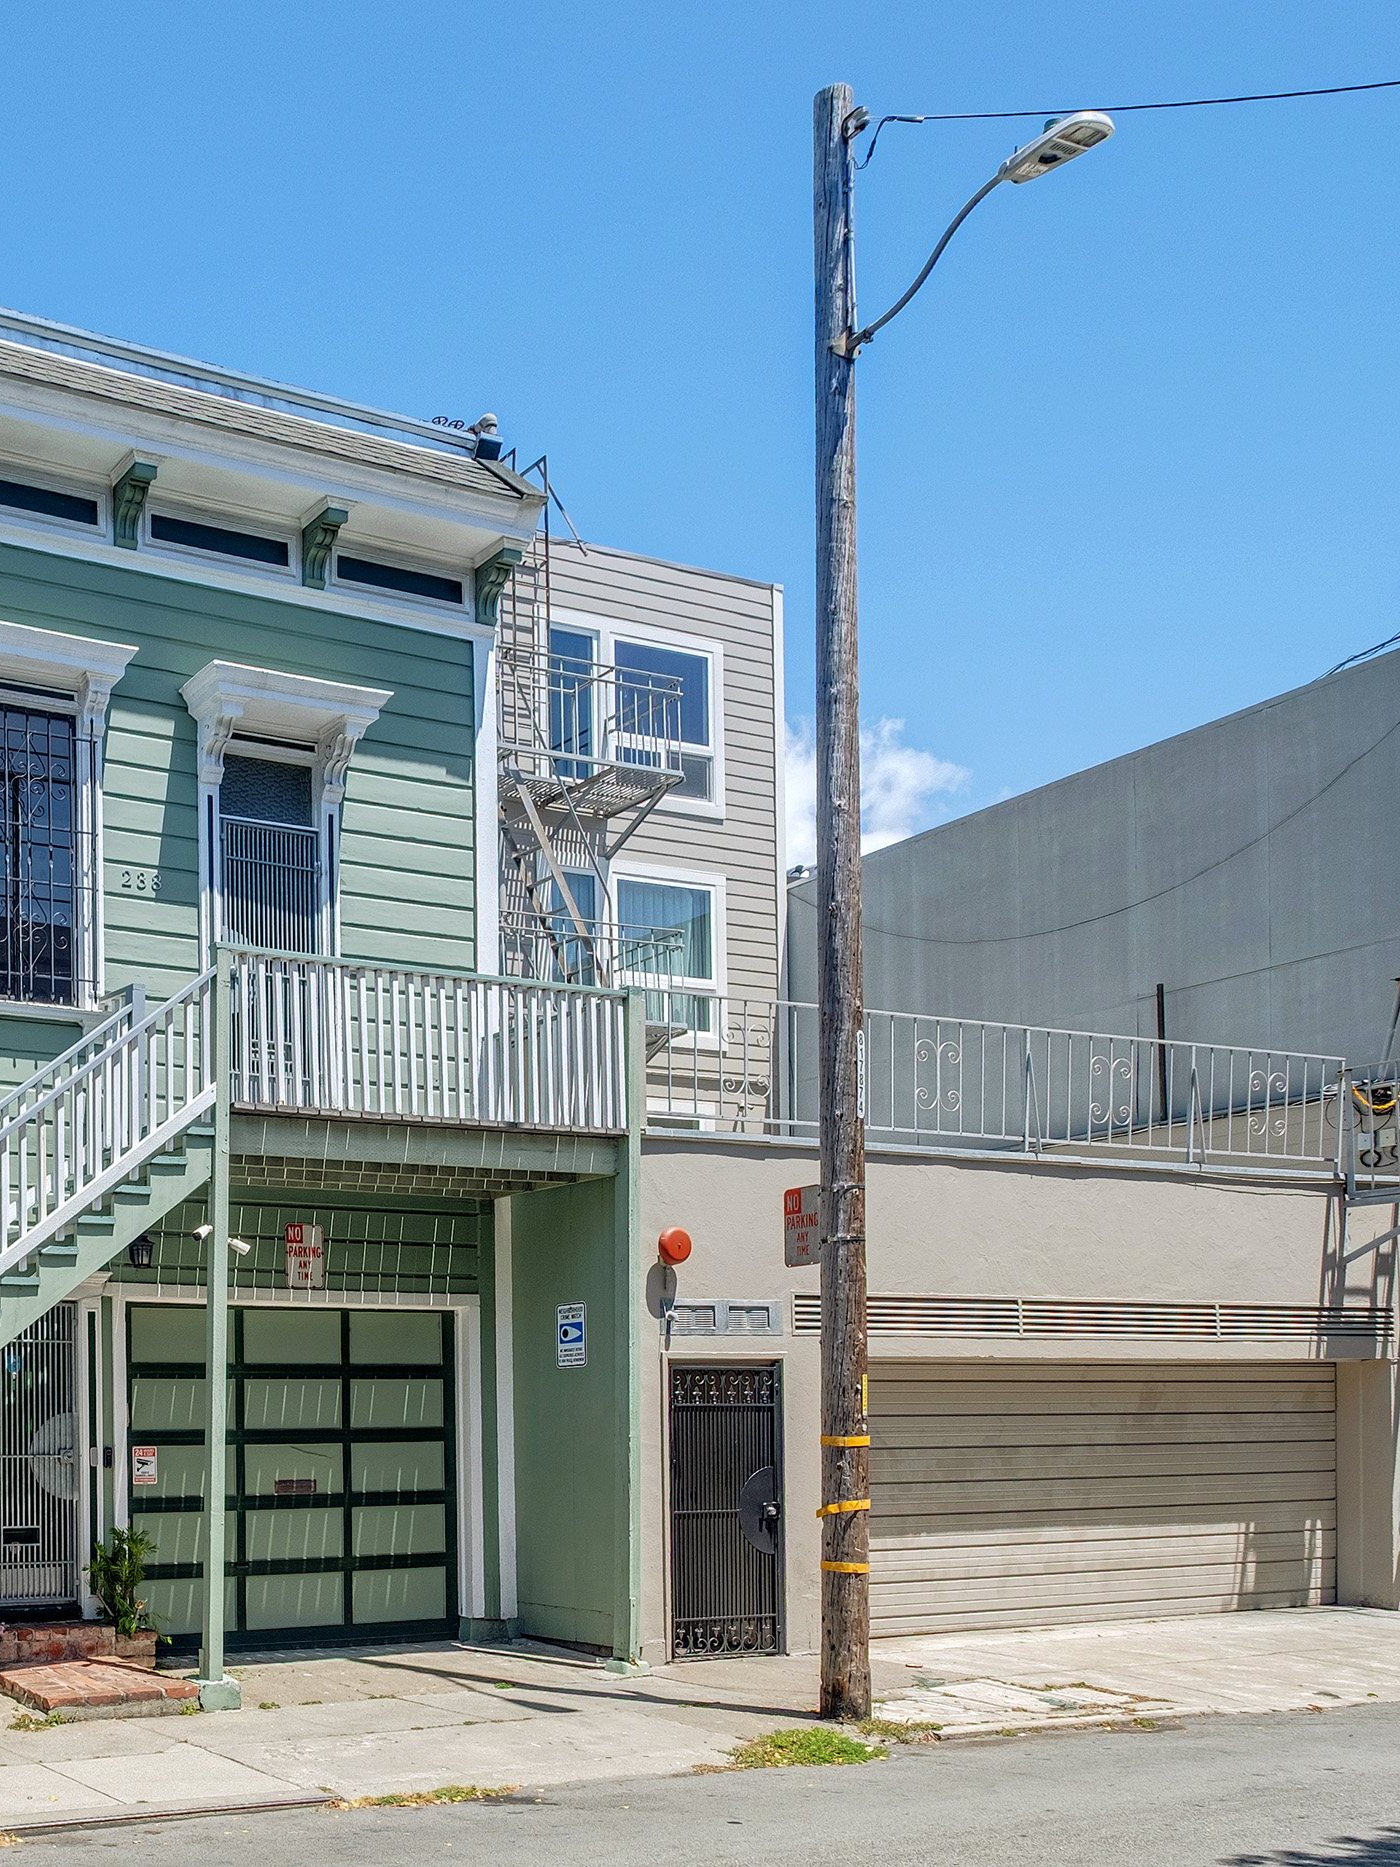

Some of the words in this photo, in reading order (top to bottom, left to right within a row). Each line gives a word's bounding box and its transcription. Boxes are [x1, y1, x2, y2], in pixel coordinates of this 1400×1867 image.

[121, 870, 162, 891] 238
[786, 1193, 799, 1212] NO
[786, 1212, 819, 1231] PARKING
[288, 1226, 302, 1241] NO
[797, 1231, 809, 1243] ANY
[288, 1245, 321, 1258] PARKING
[796, 1244, 810, 1256] TIME
[298, 1260, 312, 1269] ANY
[297, 1271, 313, 1281] TIME
[134, 1448, 143, 1456] 24
